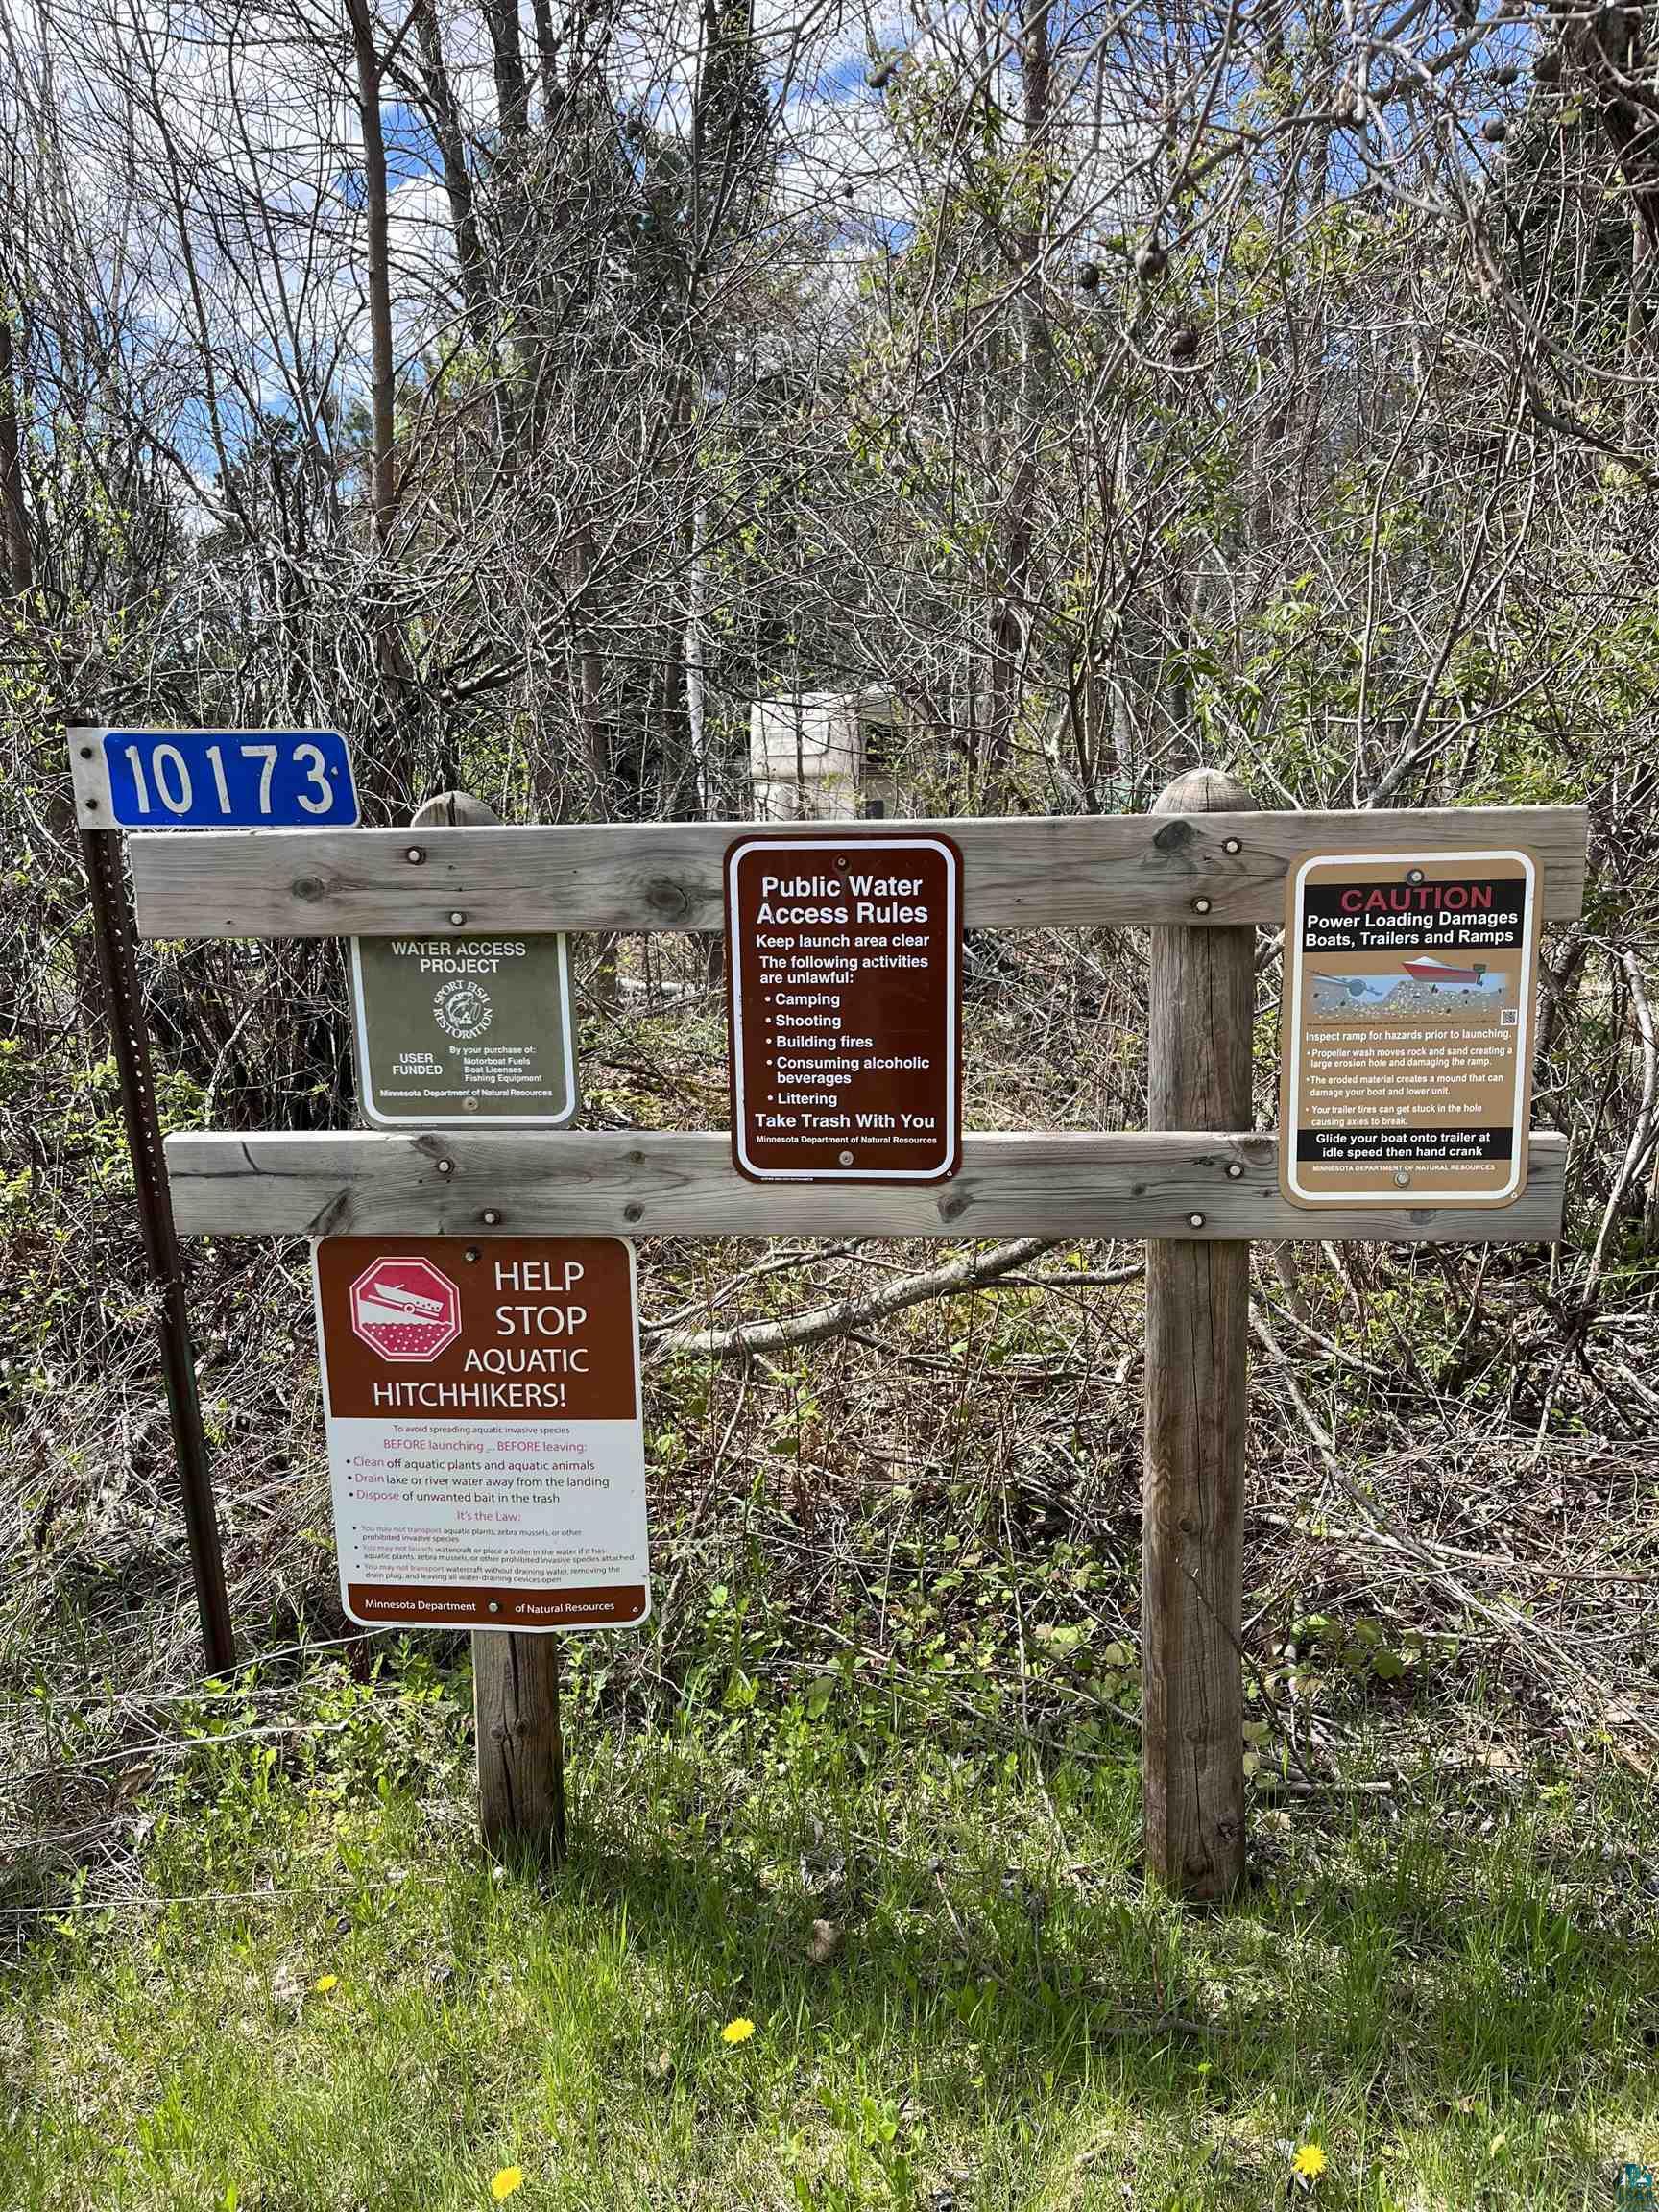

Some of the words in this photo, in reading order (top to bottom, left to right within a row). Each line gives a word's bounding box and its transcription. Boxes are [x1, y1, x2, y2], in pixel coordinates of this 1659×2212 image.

[125, 743, 333, 814] 10173
[762, 876, 841, 898] Public
[848, 875, 924, 897] Water
[1341, 885, 1492, 912] CAUTION
[757, 902, 848, 925] Access
[856, 902, 928, 923] Rules
[1307, 915, 1360, 928] Power
[1365, 913, 1433, 929] Loading
[1439, 912, 1518, 928] Damages
[756, 934, 795, 950] Keep
[799, 934, 850, 948] launch
[854, 937, 888, 947] area
[892, 933, 930, 947] clear
[1306, 933, 1356, 948] Boats,
[1360, 931, 1420, 946] Trailers
[1424, 930, 1454, 944] and
[1458, 930, 1514, 945] Ramps
[392, 942, 452, 956] WATER
[456, 942, 526, 957] ACCESS
[420, 959, 500, 973] PROJECT
[759, 955, 787, 968] The
[791, 955, 858, 971] following
[862, 955, 928, 968] activities
[759, 974, 782, 984] are
[787, 972, 854, 984] unlawful:
[433, 979, 465, 1005] SPORT
[467, 981, 491, 1003] FISH
[775, 993, 840, 1008] Camping
[433, 1007, 493, 1039] RESTORATION
[775, 1014, 842, 1029] Shooting
[776, 1035, 837, 1050] Building
[840, 1035, 873, 1047] fires
[1306, 1032, 1339, 1043] Inspect
[1342, 1033, 1367, 1042] ramp
[1369, 1031, 1382, 1040] for
[1384, 1030, 1422, 1040] hazards
[1425, 1030, 1448, 1041] prior
[1450, 1030, 1459, 1039] to
[1462, 1029, 1512, 1040] launching.
[399, 1052, 434, 1064] USER
[448, 1046, 461, 1055] By
[483, 1046, 522, 1055] purchase
[1311, 1049, 1351, 1058] Propeller
[1407, 1047, 1427, 1056] rock
[1447, 1046, 1468, 1055] sand
[1470, 1046, 1505, 1056] creating
[392, 1065, 443, 1075] FUNDED
[776, 1057, 859, 1072] Consuming
[863, 1056, 930, 1069] alcoholic
[1310, 1059, 1332, 1070] large
[1407, 1057, 1450, 1068] damaging
[1451, 1057, 1465, 1066] the
[1467, 1058, 1492, 1067] ramp.
[465, 1074, 496, 1083] Fishing
[497, 1074, 542, 1083] Equipment
[777, 1071, 852, 1087] beverages
[1310, 1075, 1326, 1084] The
[1328, 1075, 1358, 1084] eroded
[1436, 1074, 1467, 1083] mound
[778, 1093, 838, 1107] Littering
[1310, 1089, 1343, 1098] damage
[1345, 1089, 1367, 1097] your
[1367, 1087, 1385, 1095] boat
[1387, 1087, 1405, 1095] and
[1406, 1087, 1430, 1095] lower
[755, 1113, 797, 1128] Take
[801, 1113, 851, 1128] Trash
[856, 1113, 895, 1128] With
[900, 1114, 935, 1128] You
[757, 1135, 799, 1143] Minnesota
[801, 1135, 849, 1145] Department
[1315, 1133, 1347, 1143] Glide
[1350, 1135, 1378, 1145] your
[1381, 1133, 1407, 1142] boat
[1410, 1133, 1437, 1142] onto
[1440, 1132, 1476, 1142] trailer
[1479, 1132, 1490, 1142] at
[1322, 1147, 1344, 1157] idle
[1347, 1147, 1382, 1159] speed
[1385, 1146, 1412, 1157] then
[1416, 1146, 1446, 1157] hand
[1449, 1146, 1483, 1156] crank
[493, 1262, 585, 1291] HELP
[496, 1306, 587, 1335] STOP
[464, 1349, 589, 1375] AQUATIC
[373, 1382, 567, 1407] HITCHHIKERS!
[405, 1425, 427, 1433] avoid
[430, 1425, 470, 1435] spreading
[540, 1427, 570, 1435] species
[384, 1439, 427, 1450] BEFORE
[429, 1440, 484, 1453] launching
[497, 1441, 541, 1452] BEFORE
[543, 1441, 588, 1454] leaving:
[353, 1456, 384, 1467] Clean
[387, 1458, 401, 1468] off
[404, 1459, 445, 1471] aquatic
[447, 1459, 481, 1471] plants
[484, 1460, 505, 1470] and
[508, 1460, 549, 1472] aquatic
[552, 1460, 595, 1470] animals
[354, 1474, 384, 1483] Drain
[386, 1475, 408, 1484] lake
[424, 1477, 449, 1485] river
[451, 1478, 483, 1486] water
[486, 1479, 514, 1489] away
[517, 1477, 543, 1486] from
[545, 1478, 565, 1487] the
[567, 1477, 610, 1488] landing
[356, 1490, 399, 1502] Dispose
[402, 1491, 413, 1501] of
[416, 1492, 471, 1502] unwanted
[474, 1492, 495, 1503] bait
[498, 1493, 508, 1503] in
[511, 1493, 530, 1503] the
[532, 1493, 560, 1503] trash
[474, 1510, 493, 1521] the
[495, 1511, 520, 1522] Law:
[365, 1599, 416, 1609] Minnesota
[418, 1600, 476, 1612] Department
[515, 1604, 525, 1613] of
[527, 1603, 563, 1613] Natural
[565, 1602, 615, 1612] Resources
